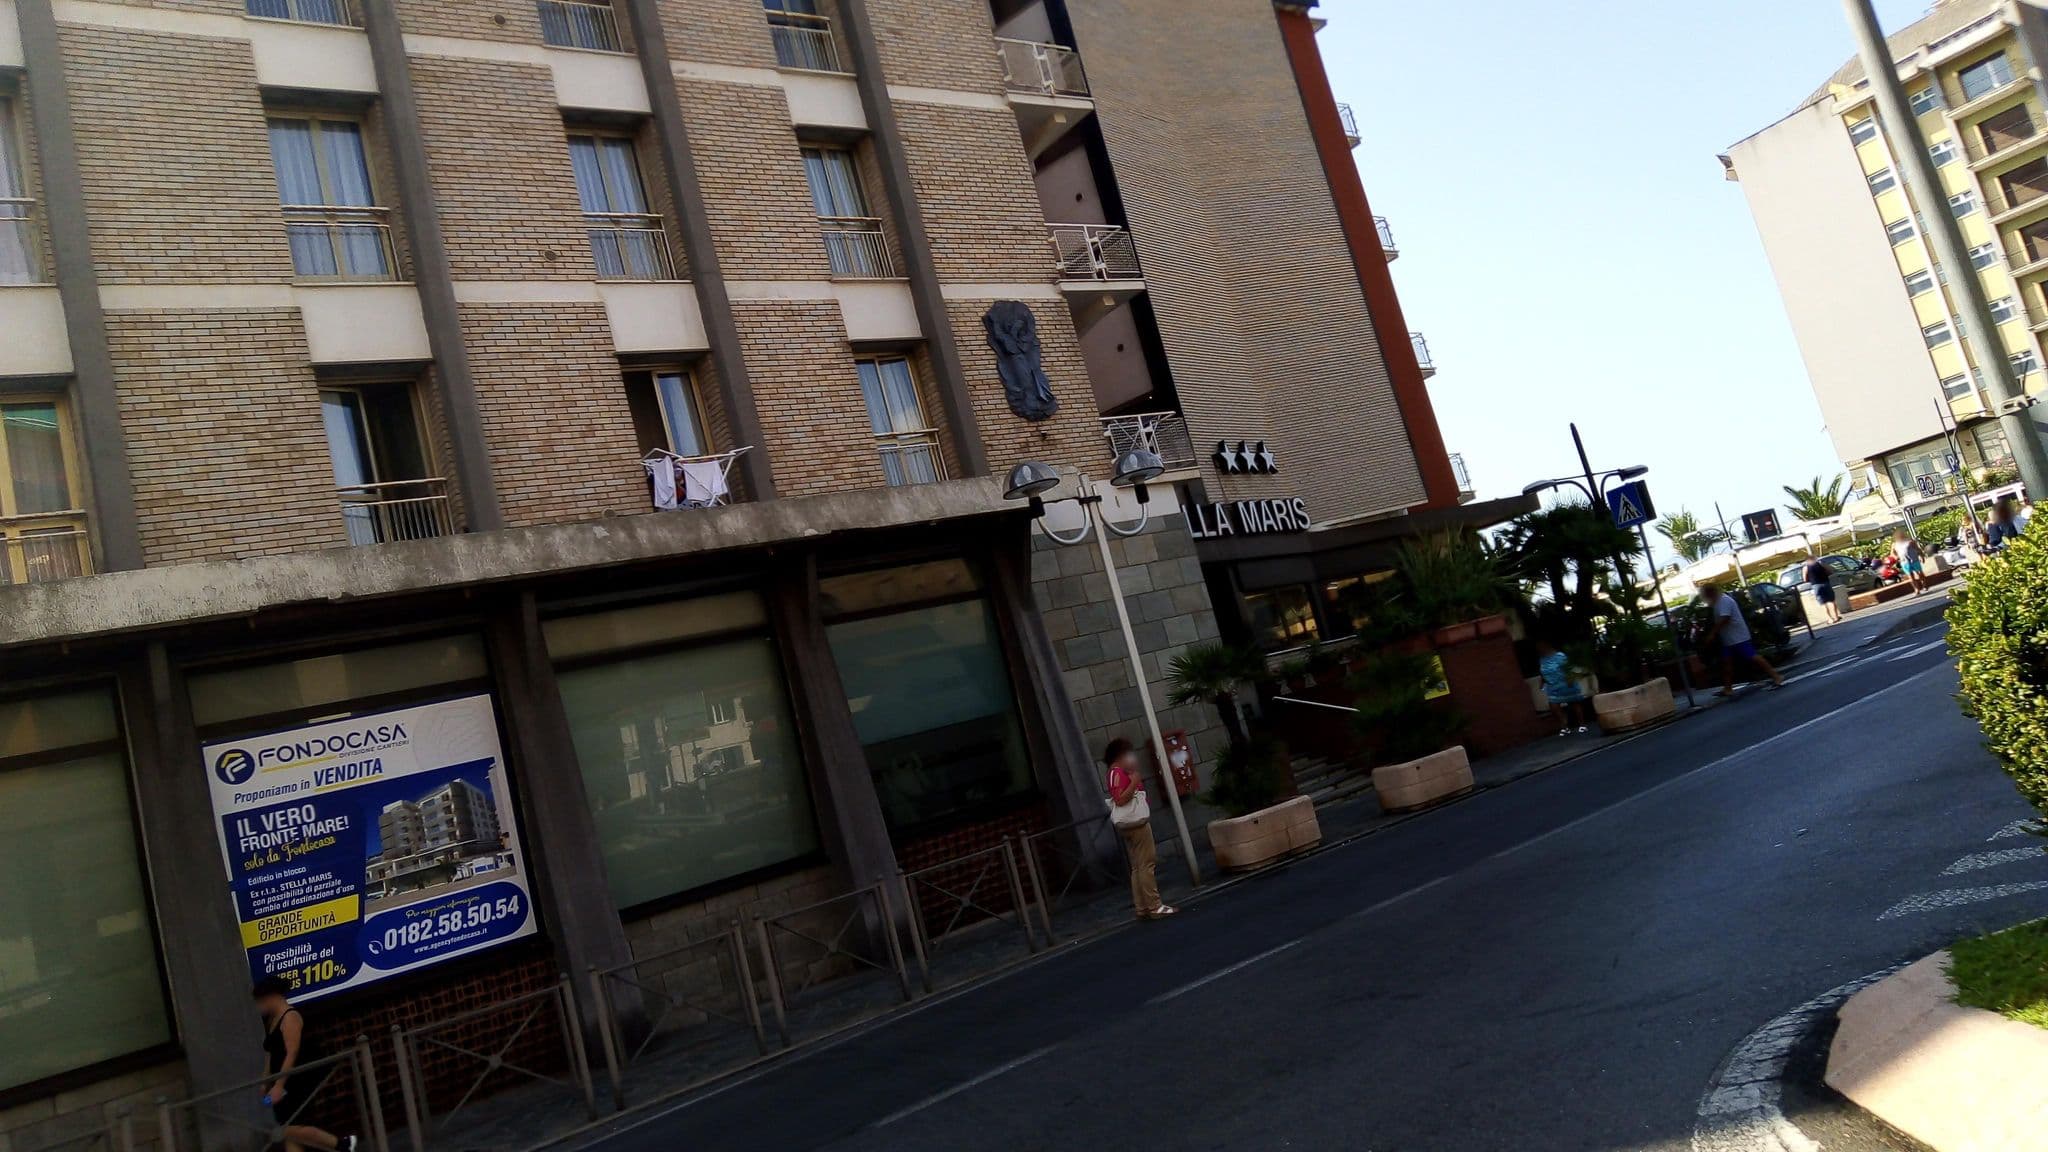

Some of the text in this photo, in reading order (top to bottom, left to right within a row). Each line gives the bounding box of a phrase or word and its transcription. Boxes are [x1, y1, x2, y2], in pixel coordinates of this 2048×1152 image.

[1238, 498, 1311, 534] MARIS
[258, 724, 407, 767] FONDOCASA
[338, 740, 410, 758] DIVISIONE CANTIERI
[234, 758, 383, 804] Proponiamo in VENDITA
[237, 804, 316, 837] IL VERO
[240, 815, 350, 853] FRONTE MARE!
[244, 836, 337, 871] solo da Fondocasa
[247, 866, 307, 886] Edificio in blocco
[250, 890, 260, 899] Ex
[280, 879, 307, 891] STELLA
[308, 872, 333, 885] MARIS
[252, 879, 342, 907] con possibilità di parziale
[254, 904, 280, 916] cambio
[282, 900, 290, 908] di
[291, 889, 334, 906] destinazione
[258, 911, 303, 931] GRANDE
[260, 910, 336, 942] OPPORTUNITÀ
[384, 895, 519, 950] 0182.58.50.54
[264, 942, 312, 964] Possibilità
[265, 945, 334, 973] di usufruire del
